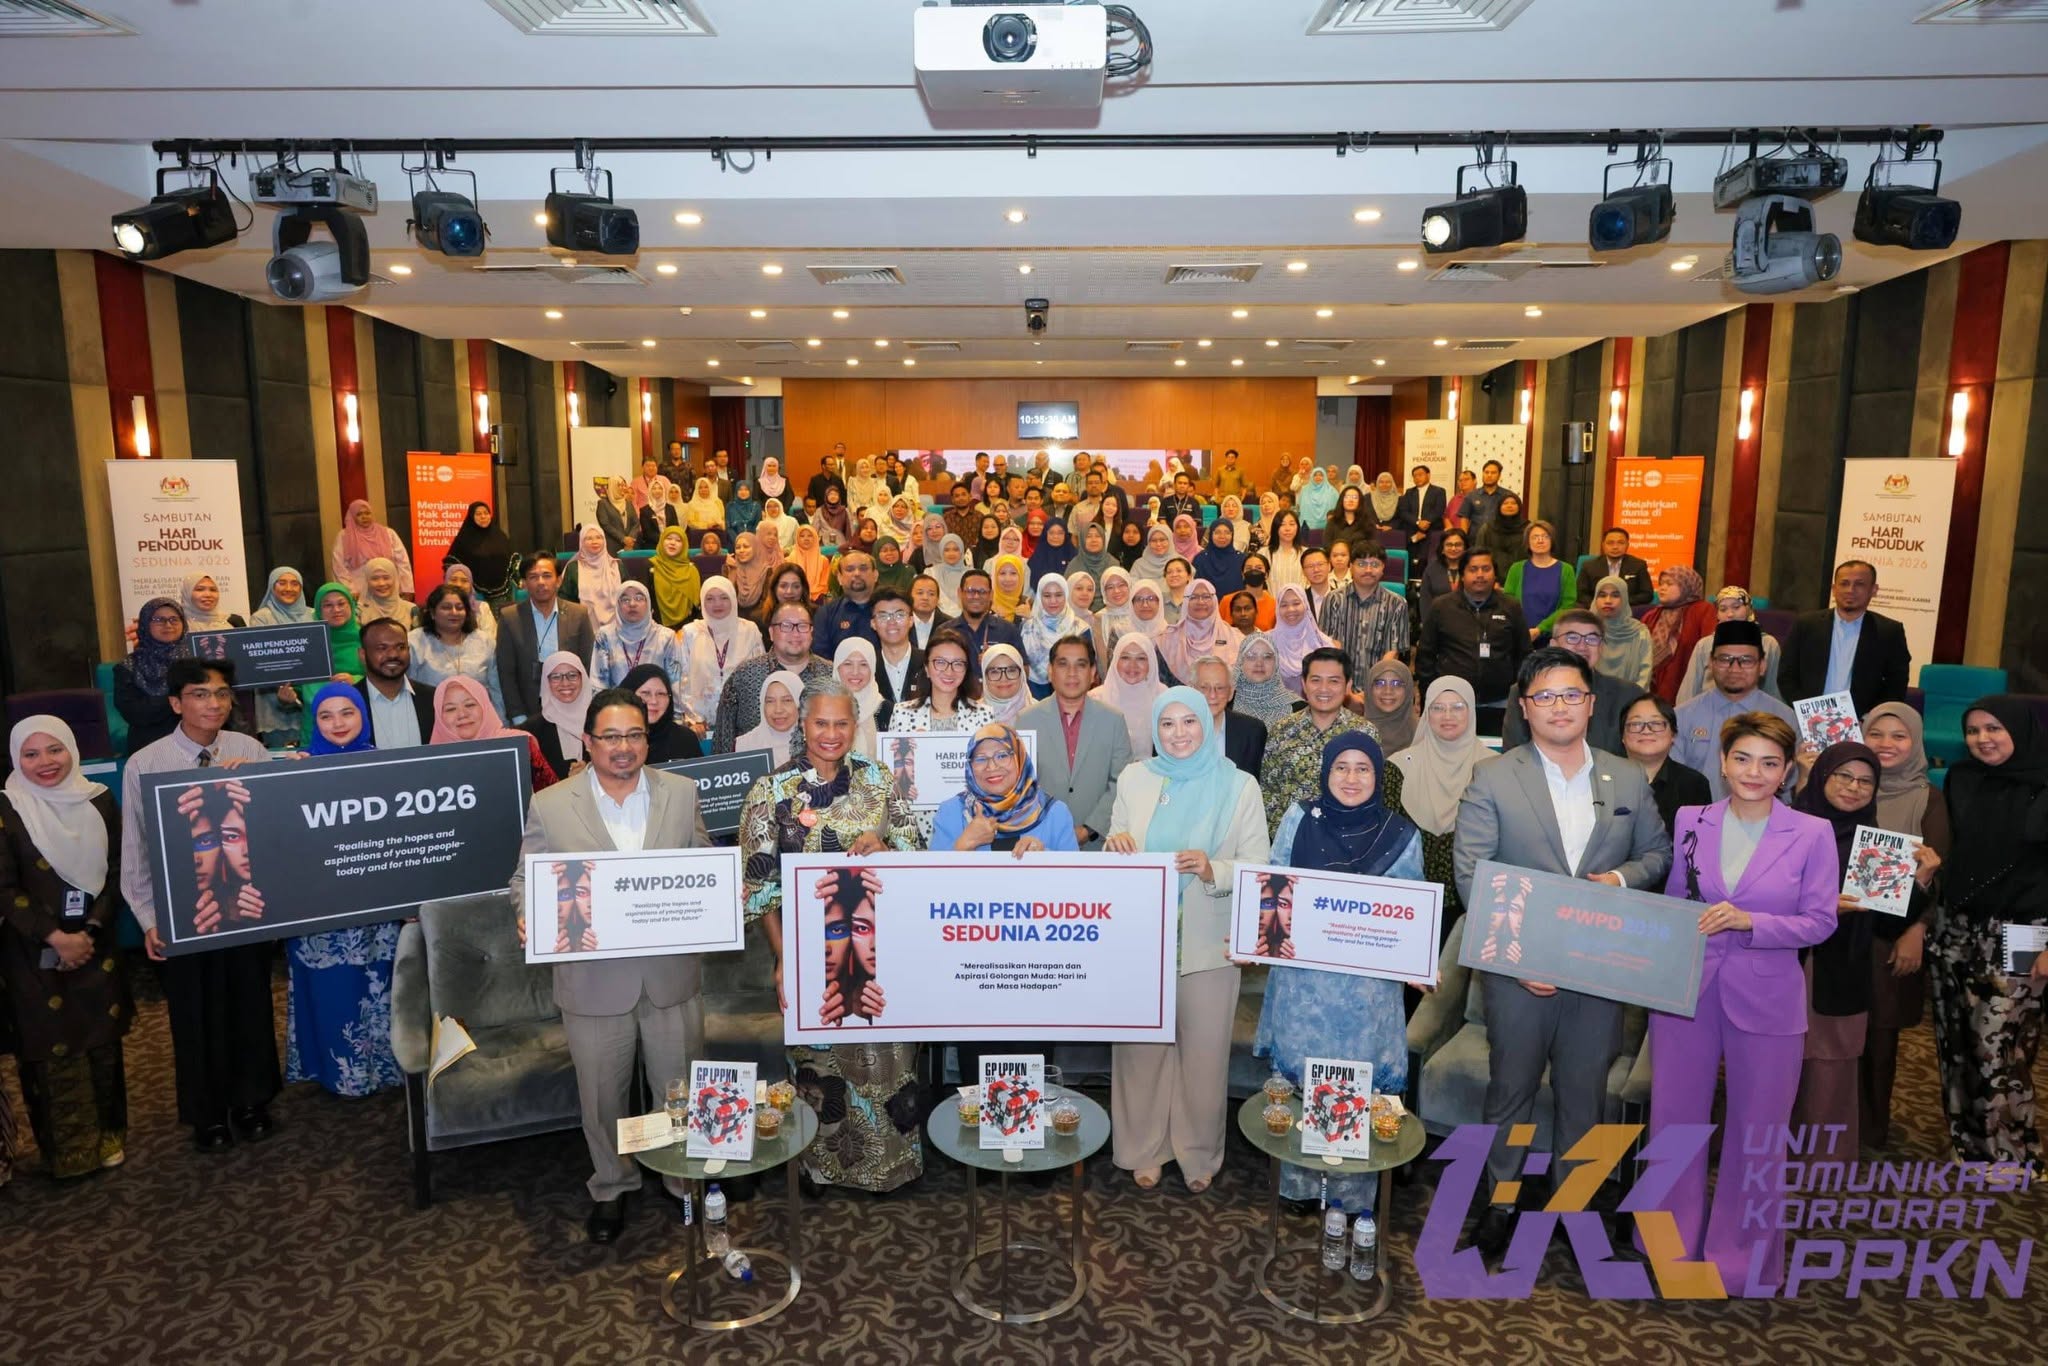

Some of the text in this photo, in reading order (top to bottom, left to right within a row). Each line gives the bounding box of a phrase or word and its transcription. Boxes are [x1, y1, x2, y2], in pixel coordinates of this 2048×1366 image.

[1061, 415, 1076, 423] AM
[1622, 500, 1678, 508] Melahirkan
[143, 513, 212, 523] SAMBUTAN
[418, 510, 462, 518] Hak dan
[1622, 508, 1662, 516] dunia di
[1862, 512, 1922, 524] SAMBUTAN
[160, 528, 196, 540] HARI
[1871, 526, 1904, 538] HARI
[138, 539, 224, 552] PENDUDUK
[418, 538, 451, 546] Untuk
[1851, 537, 1925, 552] PENDUDUK
[132, 556, 230, 568] SEDUNIA 2026
[1898, 557, 1928, 569] 2026
[242, 638, 308, 650] HARI PENDUDUK
[248, 646, 305, 657] SEDUNIA 2026
[936, 752, 958, 760] HARI
[940, 762, 966, 770] SEDU
[694, 772, 750, 791] PD 2026
[300, 784, 476, 829] WPD 2026
[386, 836, 402, 846] the
[404, 832, 434, 844] hopes
[436, 829, 455, 838] and
[1860, 830, 1904, 850] GP LPPKN
[324, 852, 382, 867] aspirations
[383, 848, 394, 858] of
[395, 844, 426, 858] young
[336, 865, 366, 877] today
[368, 863, 388, 872] and
[389, 860, 402, 870] for
[404, 858, 421, 867] the
[614, 873, 717, 892] #WPD2026
[930, 902, 1112, 920] HARI PENDUDUK
[1312, 896, 1414, 921] #WPD2026
[942, 924, 1099, 942] SEDUNIA 2026
[1028, 963, 1064, 971] Harapan
[1065, 962, 1082, 970] dan
[954, 973, 988, 981] Aspirasi
[990, 973, 1029, 981] Golongan
[696, 1066, 738, 1083] GP LPPKN
[986, 1062, 1027, 1076] GP LPPKN
[1312, 1064, 1354, 1082] GP LPPKN
